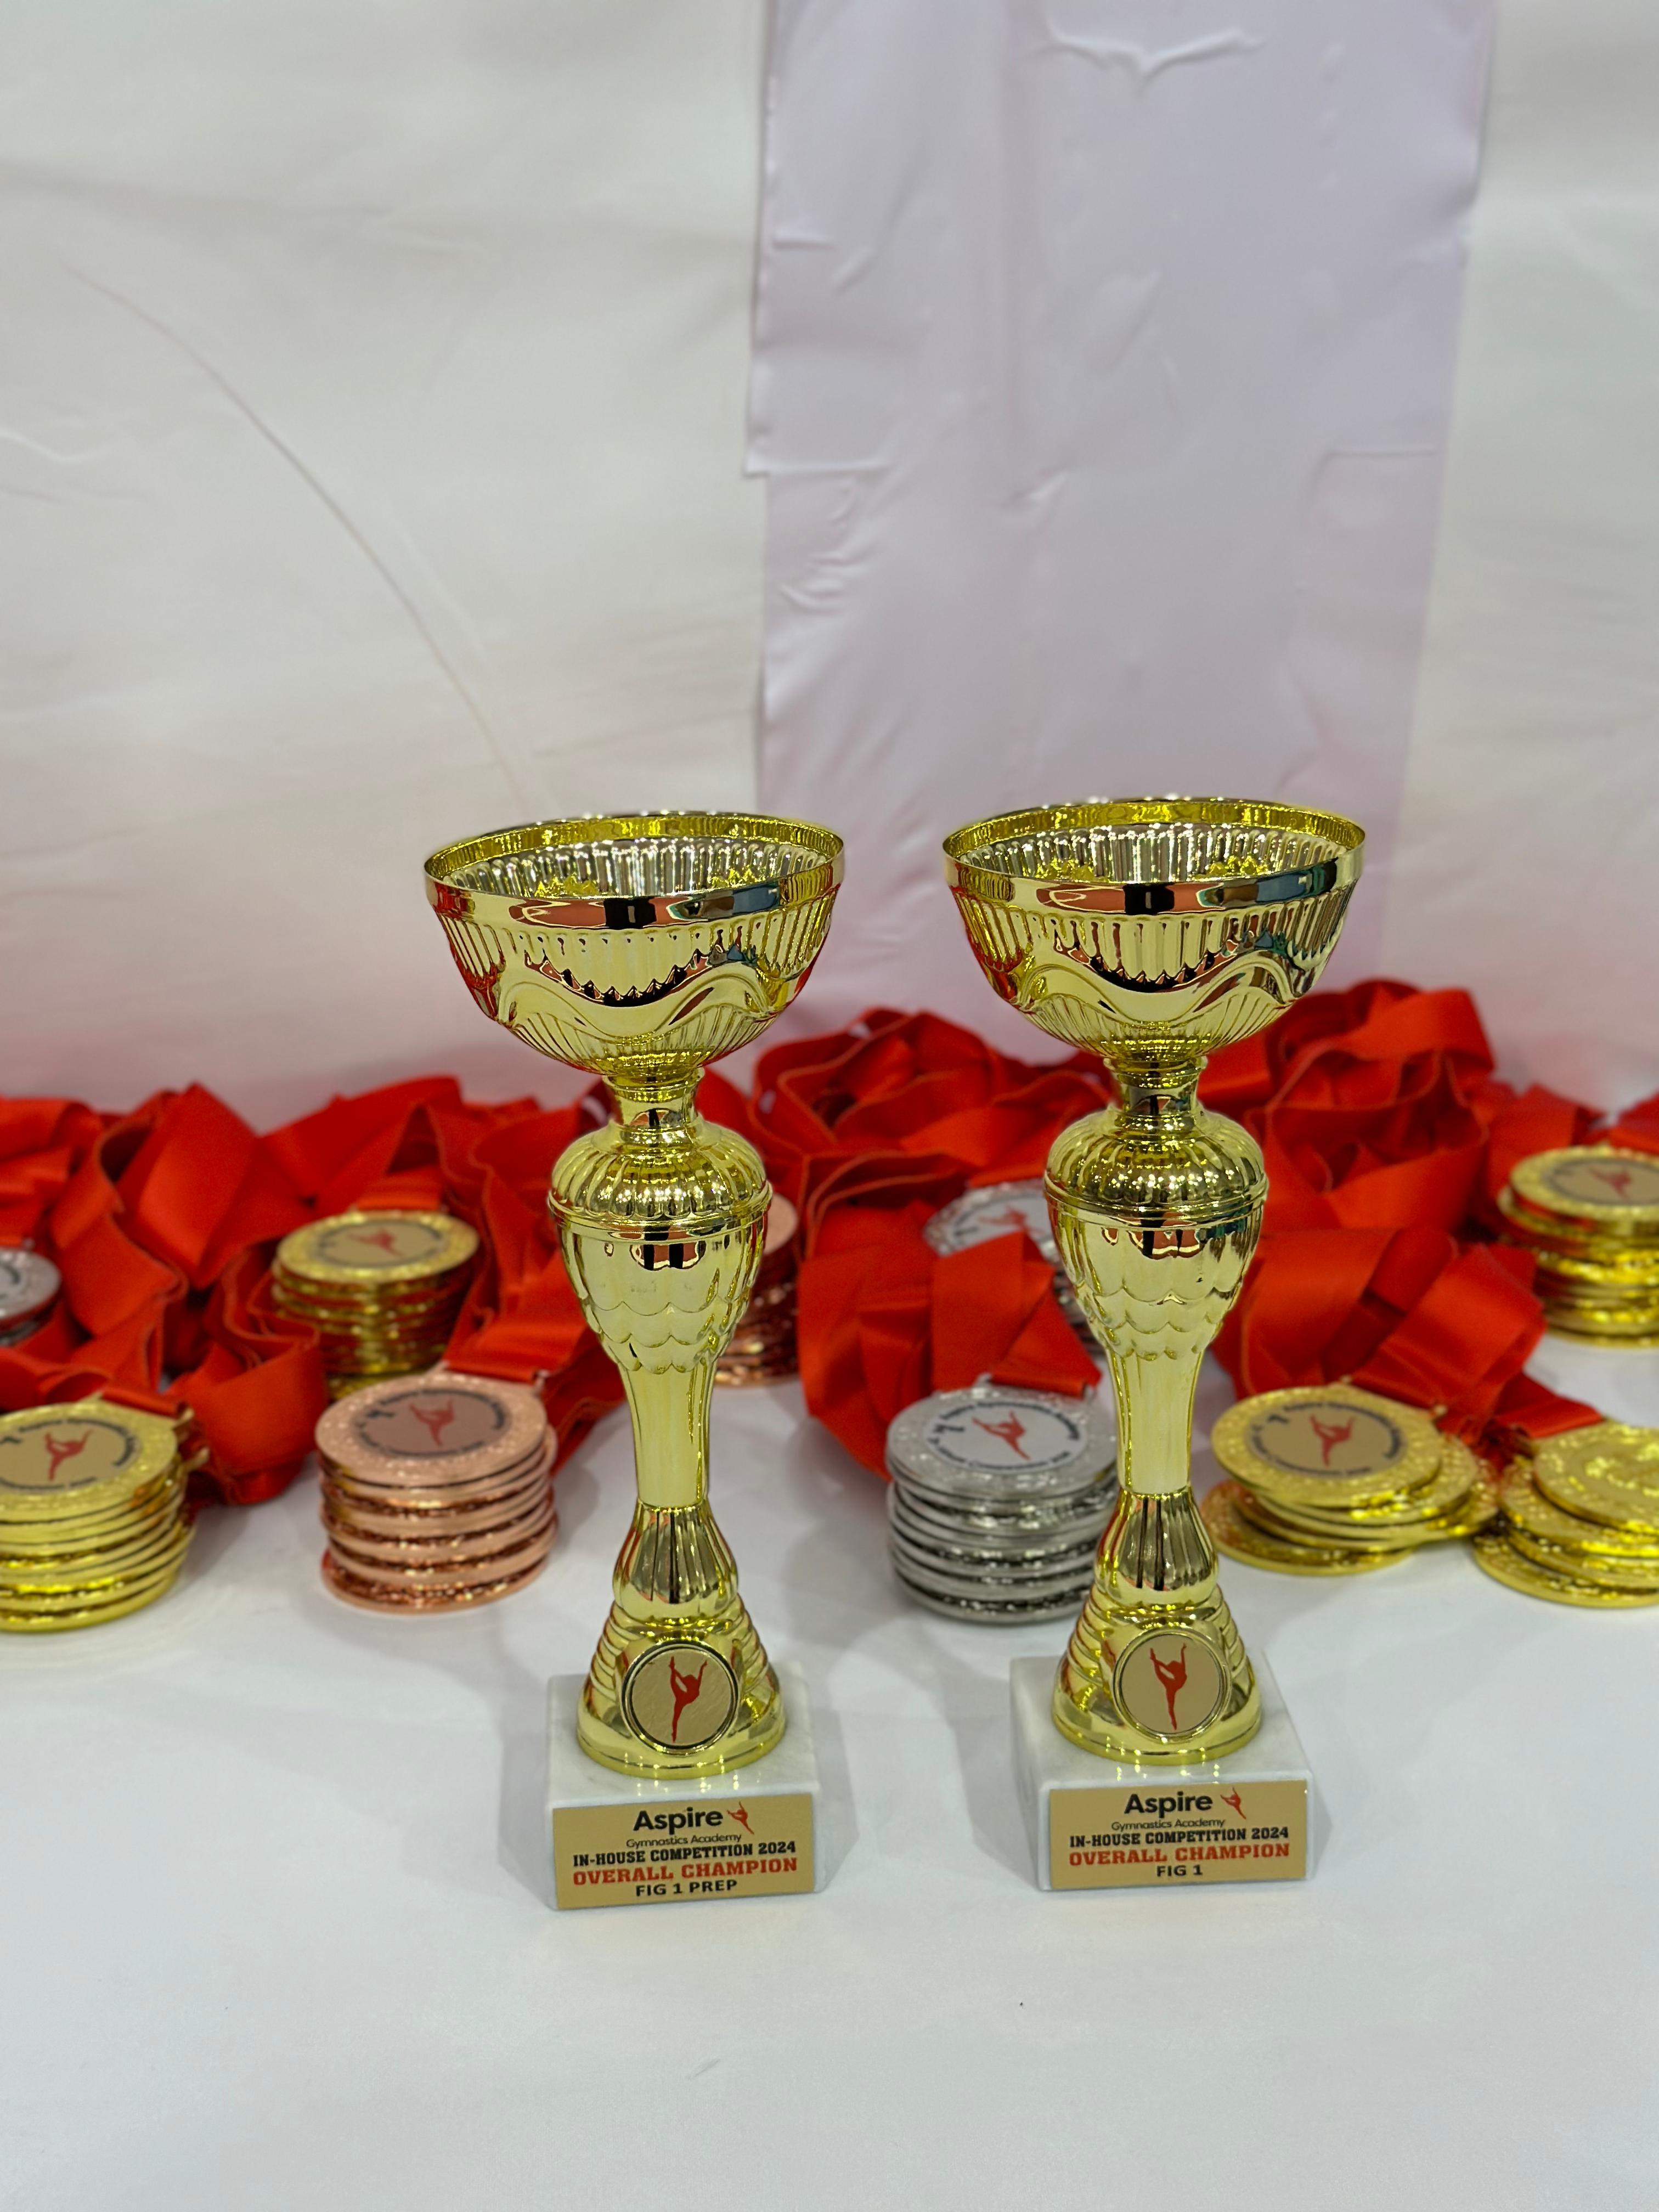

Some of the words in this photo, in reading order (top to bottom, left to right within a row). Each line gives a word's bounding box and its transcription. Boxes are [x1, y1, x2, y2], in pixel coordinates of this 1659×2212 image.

[1124, 1791, 1213, 1818] Aspire
[633, 1807, 723, 1835] Aspire
[1111, 1819, 1172, 1832] Gymnastics
[1174, 1818, 1226, 1829] Academy
[626, 1836, 689, 1849] Gymnastics
[691, 1833, 742, 1844] Academy
[1070, 1833, 1141, 1848] IN-HOUSE
[1145, 1828, 1246, 1844] COMPETITION
[1251, 1826, 1288, 1840] 2024
[573, 1850, 646, 1867] IN-HOUSE
[650, 1843, 753, 1863] COMPETITION
[758, 1841, 795, 1855] 2024
[1070, 1848, 1167, 1866] OVERALL
[1175, 1843, 1289, 1861] CHAMPION
[573, 1866, 674, 1886] OVERALL
[681, 1857, 797, 1878] CHAMPION
[1156, 1865, 1187, 1877] FIG
[1193, 1865, 1203, 1876] 1
[636, 1883, 666, 1897] FIG
[673, 1883, 682, 1894] 1
[689, 1879, 737, 1893] PREP
